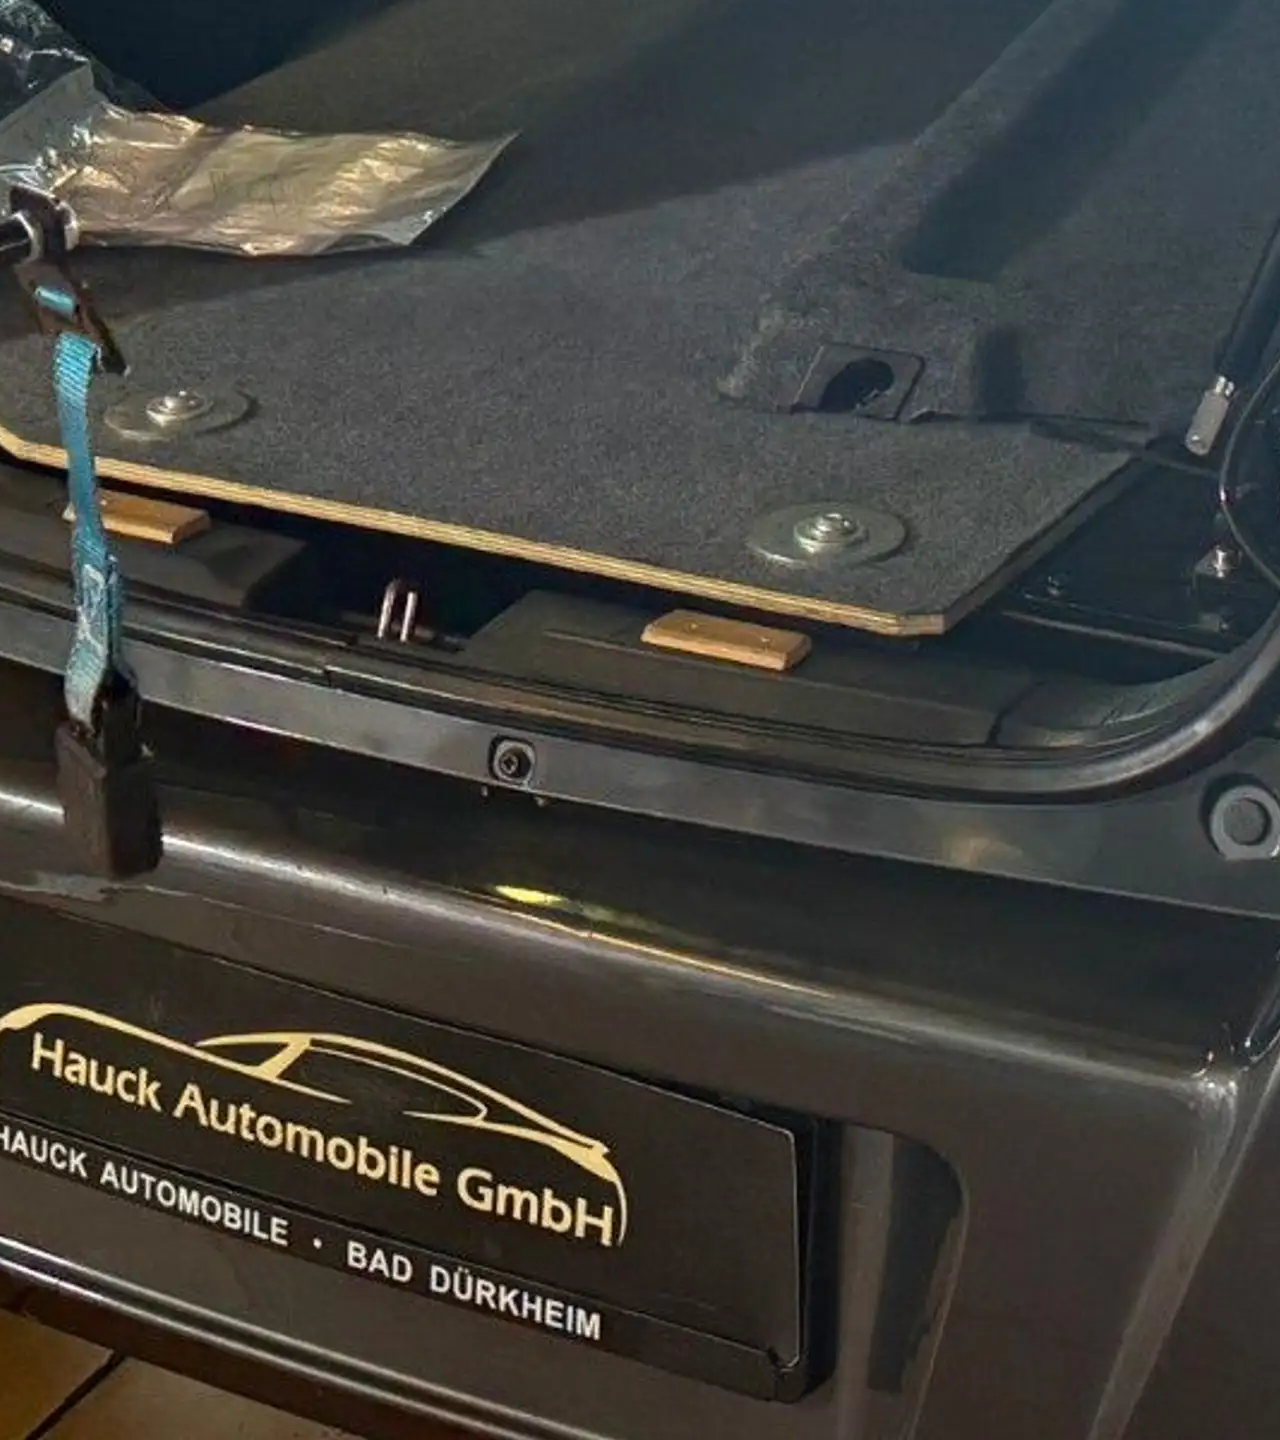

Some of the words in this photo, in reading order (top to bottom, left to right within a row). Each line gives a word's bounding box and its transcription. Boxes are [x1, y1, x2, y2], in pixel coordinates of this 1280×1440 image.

[30, 1031, 162, 1111] Hauck
[172, 1082, 441, 1197] Automobile
[456, 1167, 614, 1246] GmbH
[99, 1160, 290, 1247] AUTOMOBILE
[346, 1239, 414, 1284] BAD
[429, 1264, 601, 1341] DÜRKHEIM
